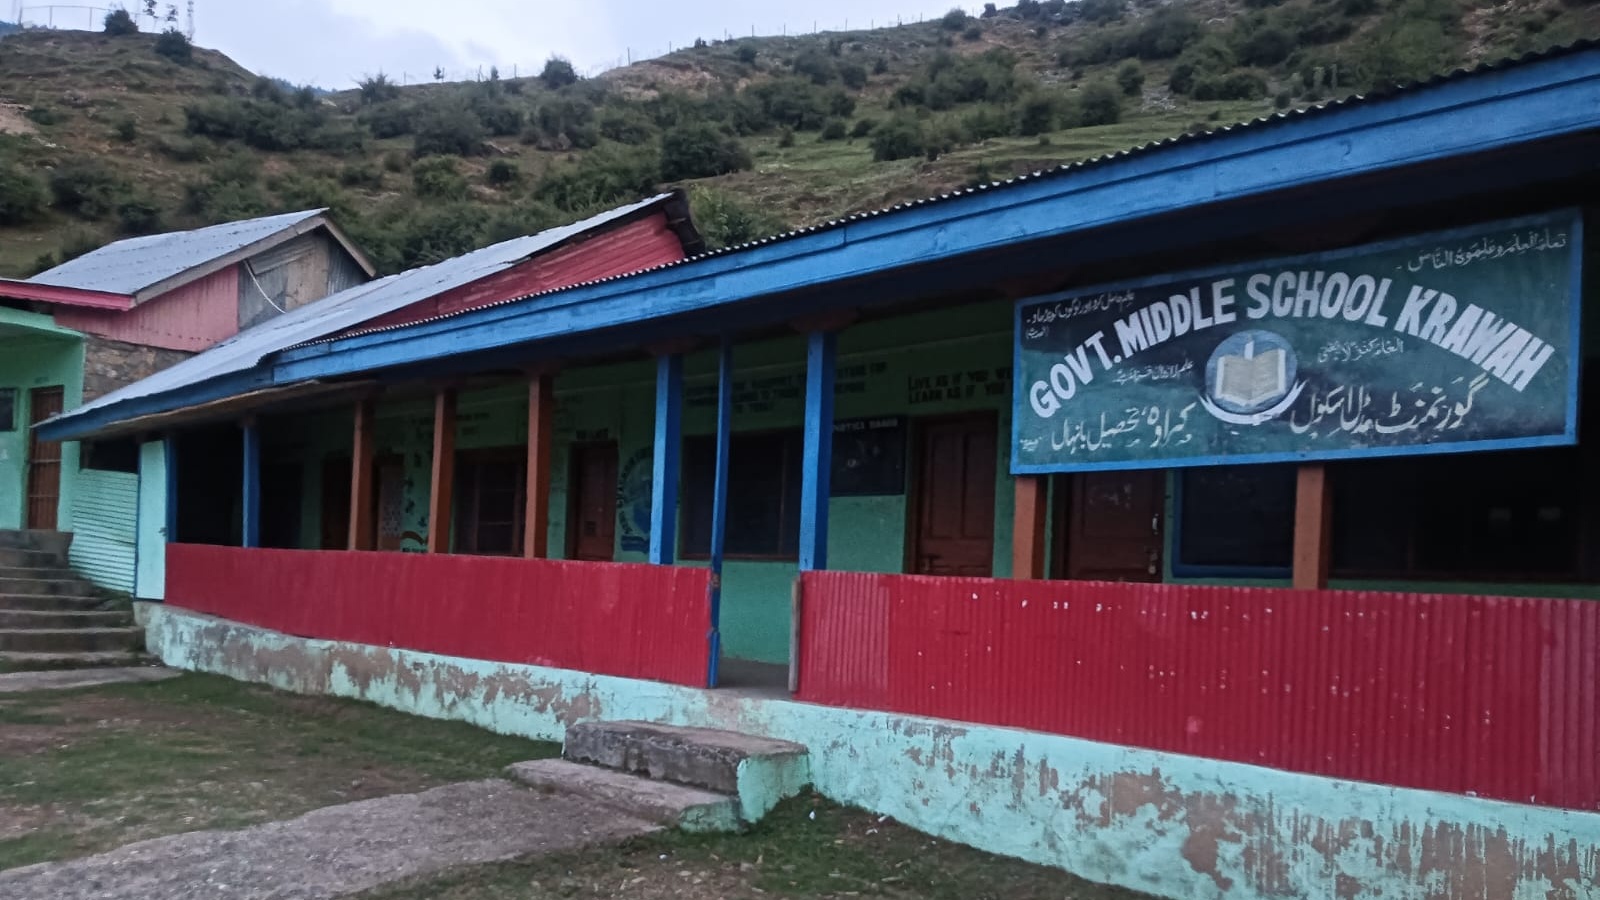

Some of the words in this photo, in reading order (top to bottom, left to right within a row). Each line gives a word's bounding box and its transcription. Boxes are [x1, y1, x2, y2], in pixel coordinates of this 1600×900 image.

[1030, 331, 1122, 418] GOVT.
[1113, 278, 1236, 358] MIDDLE
[1246, 270, 1393, 327] SCHOOL
[1393, 284, 1556, 393] KRAWAH
